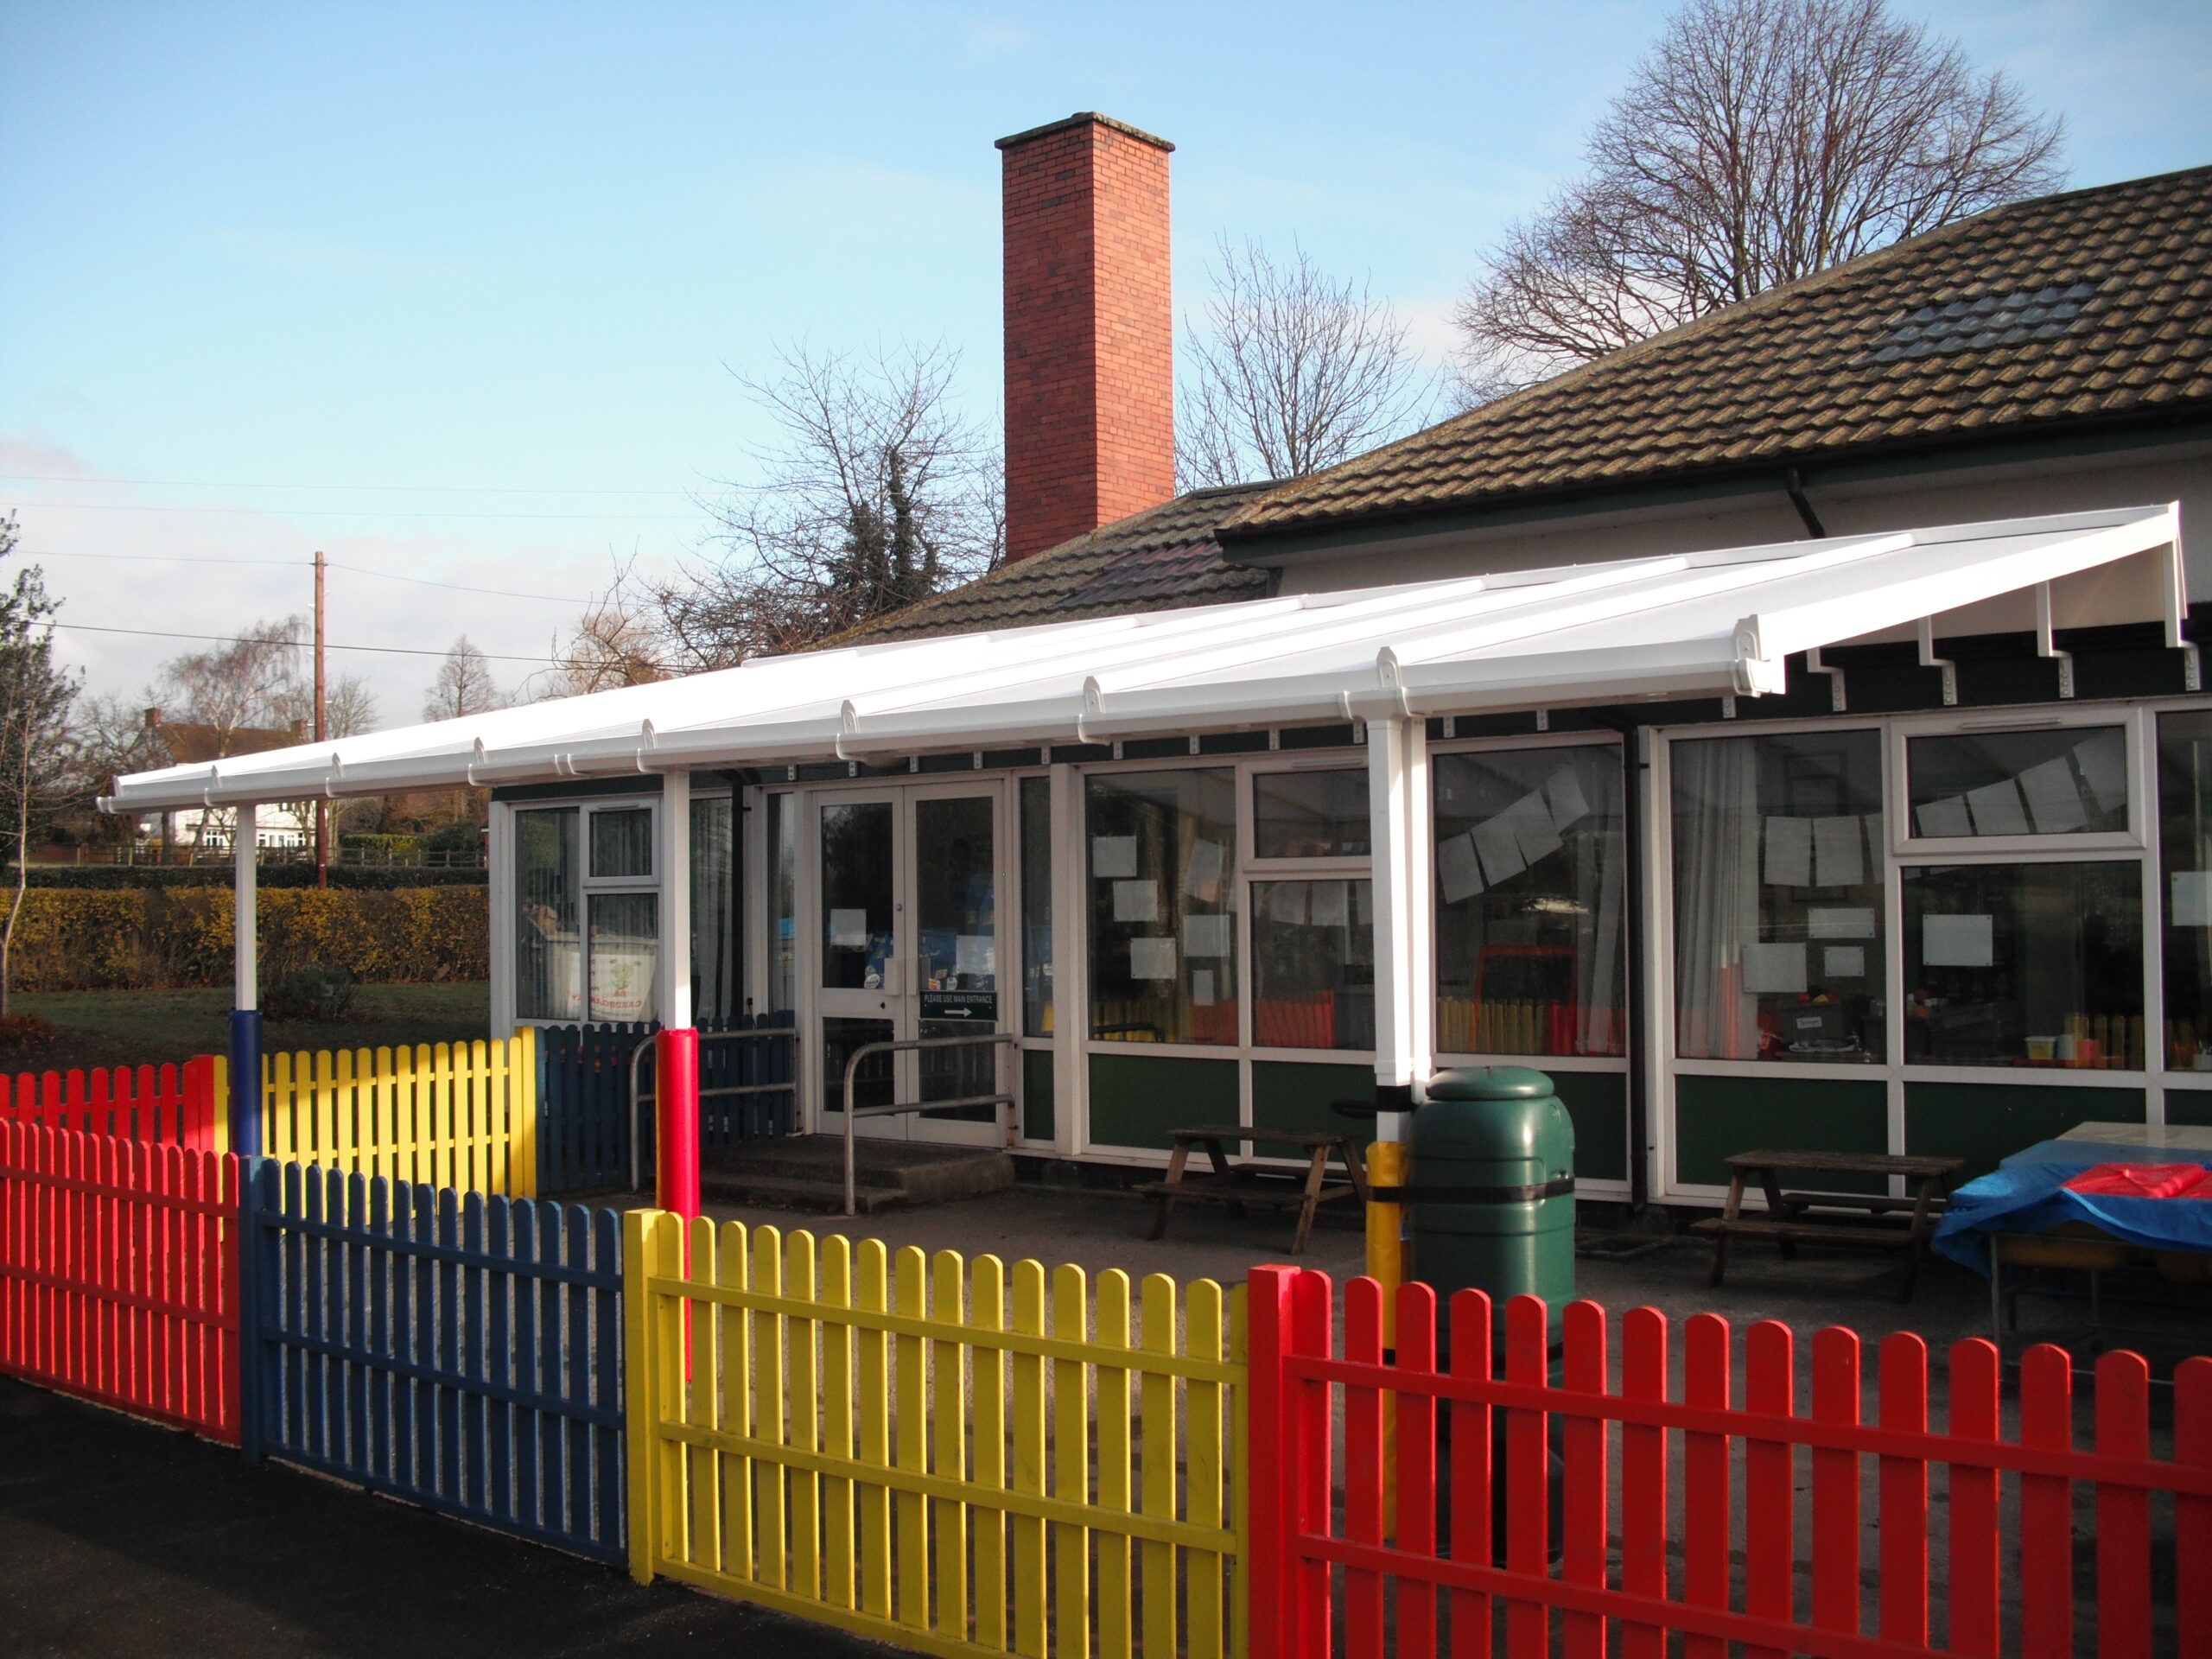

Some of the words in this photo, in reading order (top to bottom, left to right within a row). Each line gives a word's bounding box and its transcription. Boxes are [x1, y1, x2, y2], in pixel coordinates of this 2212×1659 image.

[924, 994, 942, 1003] PLEASE
[943, 995, 953, 1003] USE
[953, 995, 966, 1003] MAIN
[966, 995, 993, 1004] ENTRANCE
